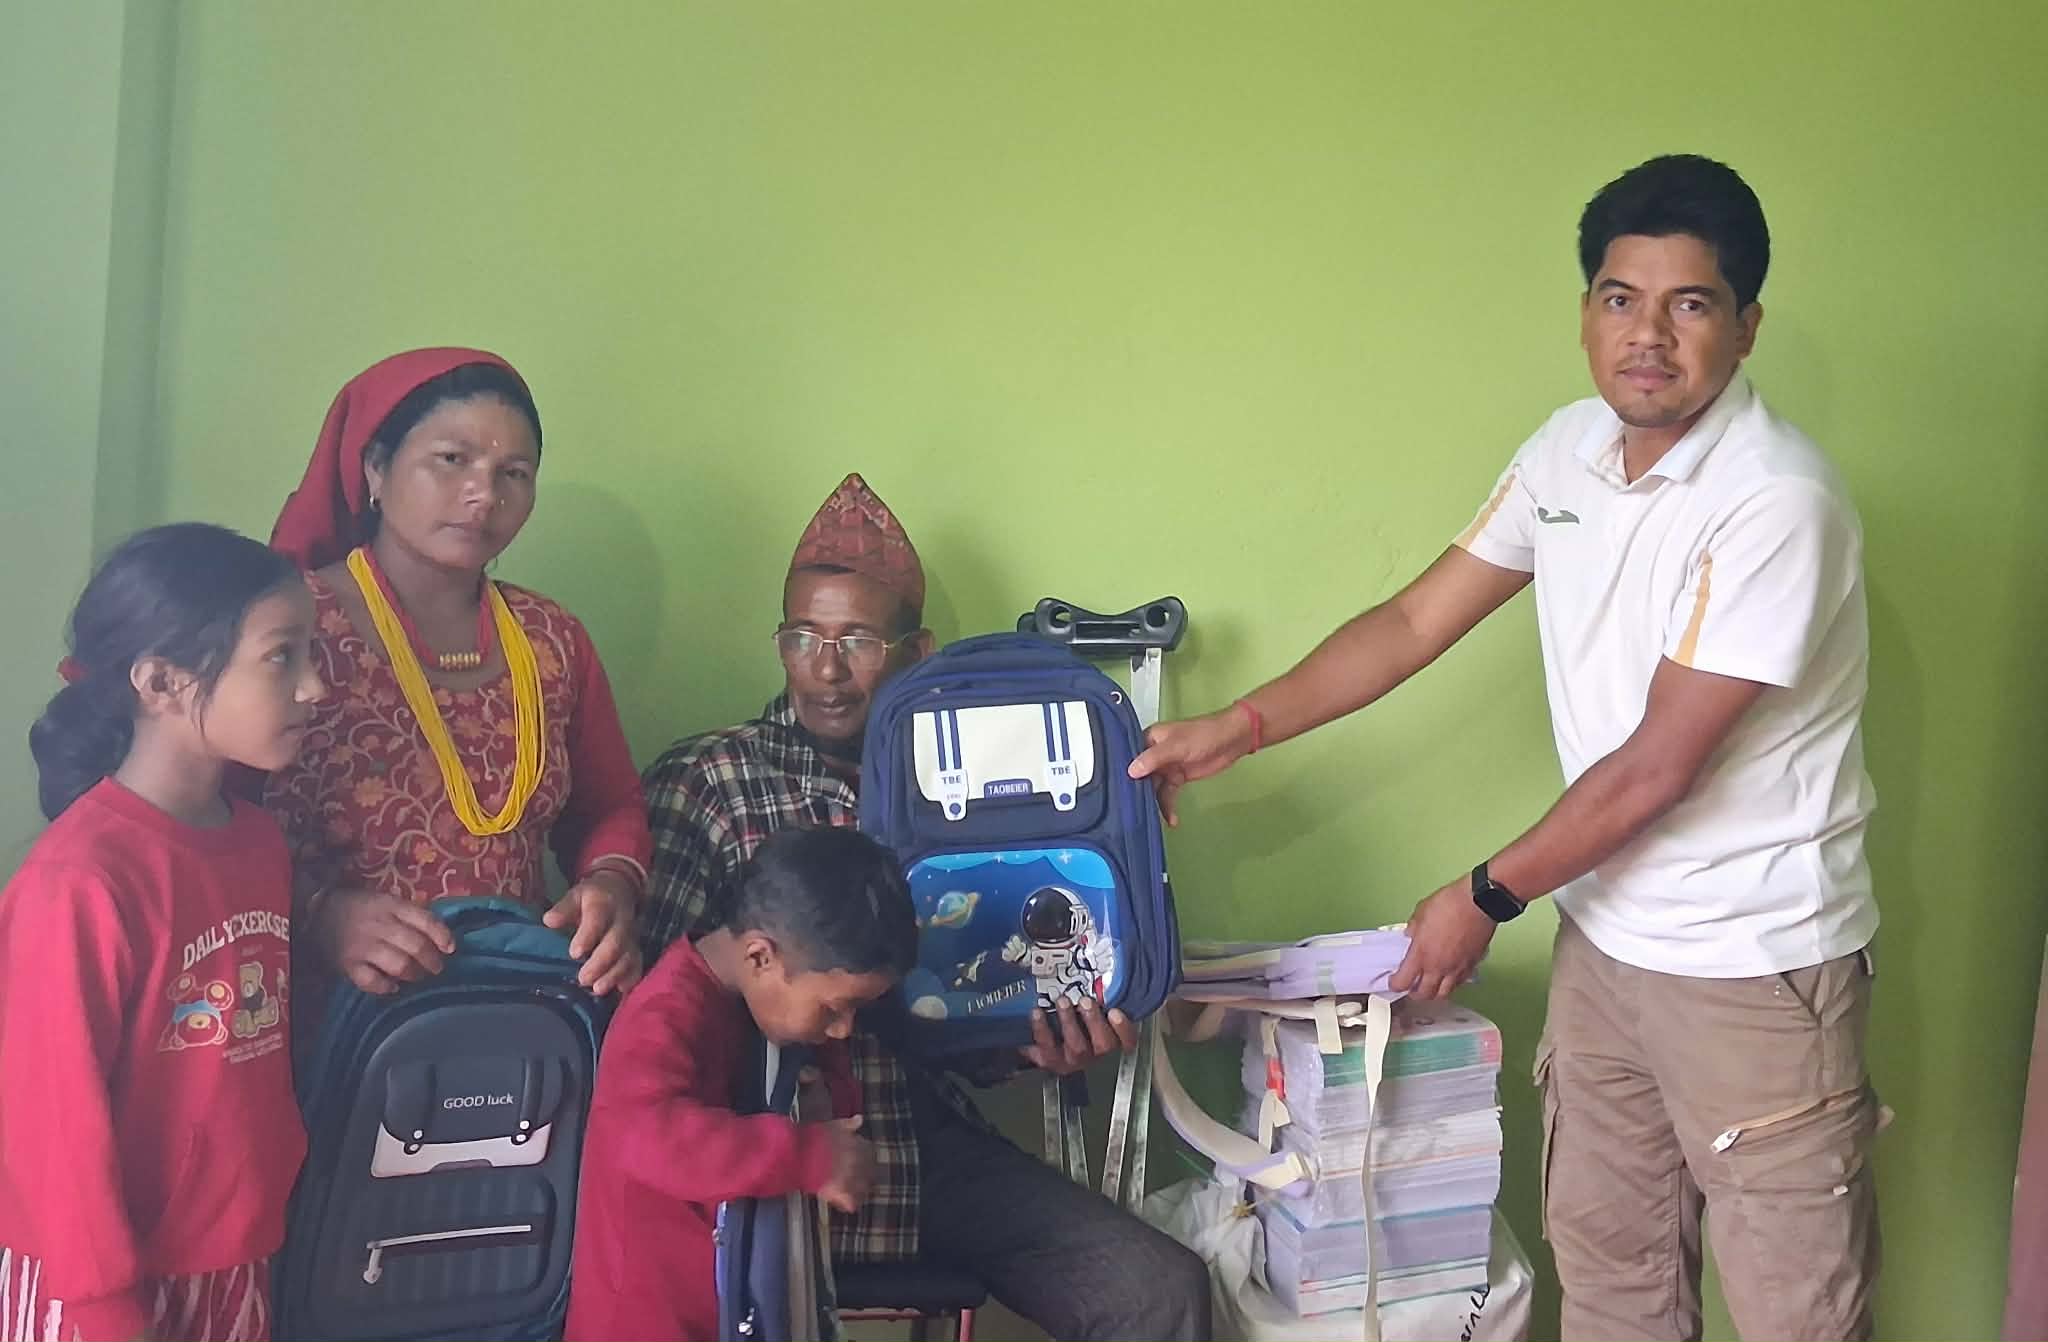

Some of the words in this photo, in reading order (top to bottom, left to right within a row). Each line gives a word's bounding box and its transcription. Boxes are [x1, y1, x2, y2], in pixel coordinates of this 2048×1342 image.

[987, 783, 1029, 796] TAOBEIER
[183, 919, 236, 971] DAILY
[443, 1095, 485, 1109] GOOD
[486, 1092, 514, 1105] luck
